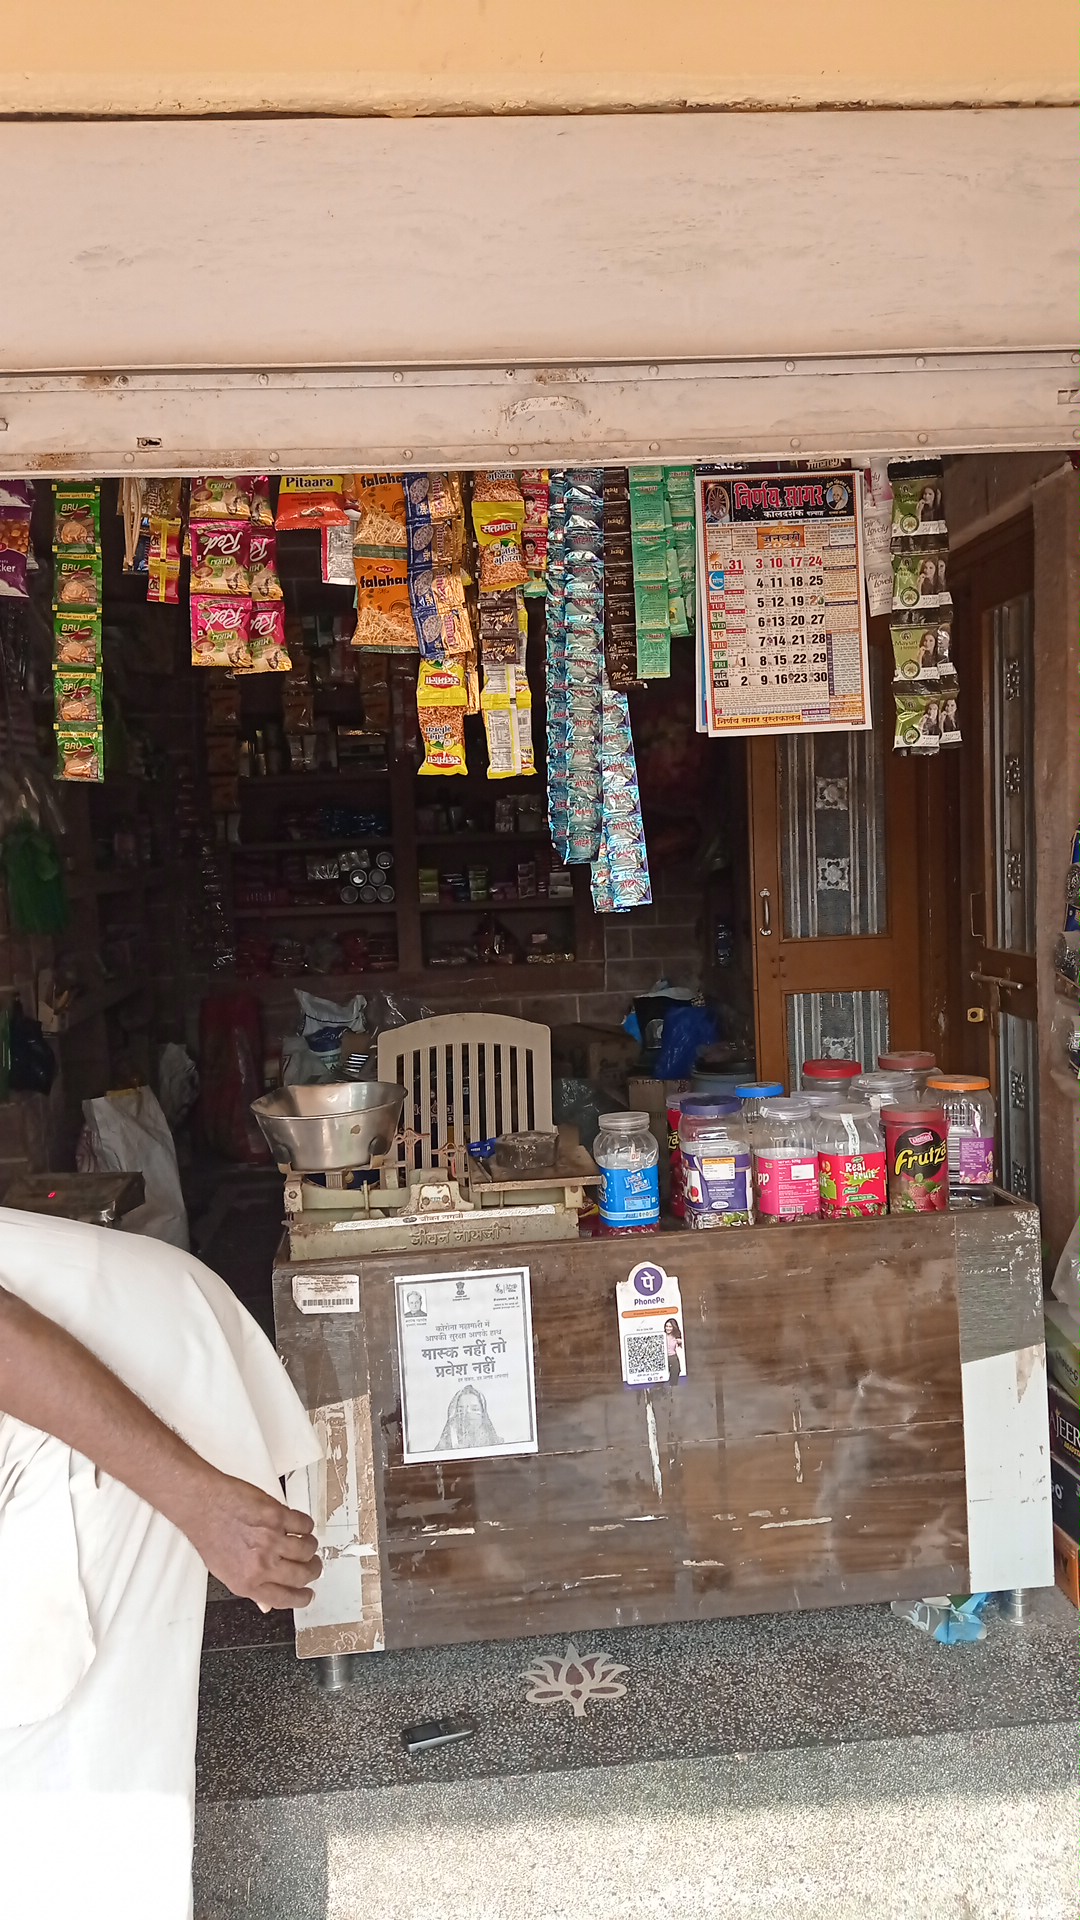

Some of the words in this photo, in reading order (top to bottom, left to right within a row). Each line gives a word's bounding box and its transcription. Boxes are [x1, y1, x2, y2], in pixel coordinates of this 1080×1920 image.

[286, 477, 334, 489] Pitaara
[733, 481, 780, 509] निर्णय
[784, 484, 823, 508] सागर
[61, 503, 79, 512] BRU
[481, 521, 517, 535] सतमोला
[203, 531, 244, 555] Red
[762, 531, 801, 543] जनवरी
[763, 541, 800, 549] 2021
[61, 563, 80, 572] BRU
[729, 559, 742, 570] 31
[756, 558, 763, 568] 3
[770, 557, 783, 568] 10
[789, 556, 803, 567] 17
[808, 555, 823, 566] 24
[756, 578, 764, 588] 4
[770, 577, 782, 588] 11
[790, 577, 803, 587] 18
[809, 575, 823, 586] 25
[757, 598, 764, 607] 5
[771, 597, 784, 607] 12
[791, 596, 804, 606] 19
[61, 623, 80, 632] BRU
[758, 617, 765, 628] 6
[772, 616, 785, 627] 13
[791, 615, 805, 626] 20
[811, 614, 825, 625] 27
[758, 636, 765, 647] 7
[773, 635, 786, 646] 14
[792, 634, 805, 645] 21
[811, 633, 825, 644] 28
[740, 656, 746, 667] 1
[760, 655, 767, 666] 8
[774, 655, 786, 665] 15
[792, 654, 807, 664] 22
[813, 653, 827, 663] 29
[740, 676, 748, 686] 2
[760, 675, 768, 685] 9
[775, 674, 788, 684] 16
[794, 673, 808, 683] 23
[814, 672, 828, 682] 30
[64, 742, 82, 751] BRU
[845, 1161, 866, 1173] Real
[640, 1271, 656, 1292] पे
[633, 1296, 665, 1306] PhonePe
[435, 1322, 457, 1332] कोरोना
[421, 1346, 459, 1361] मास्क
[462, 1339, 487, 1357] नहीं
[490, 1337, 507, 1354] तो
[435, 1360, 468, 1378] प्रवेश
[472, 1356, 496, 1374] नहीं
